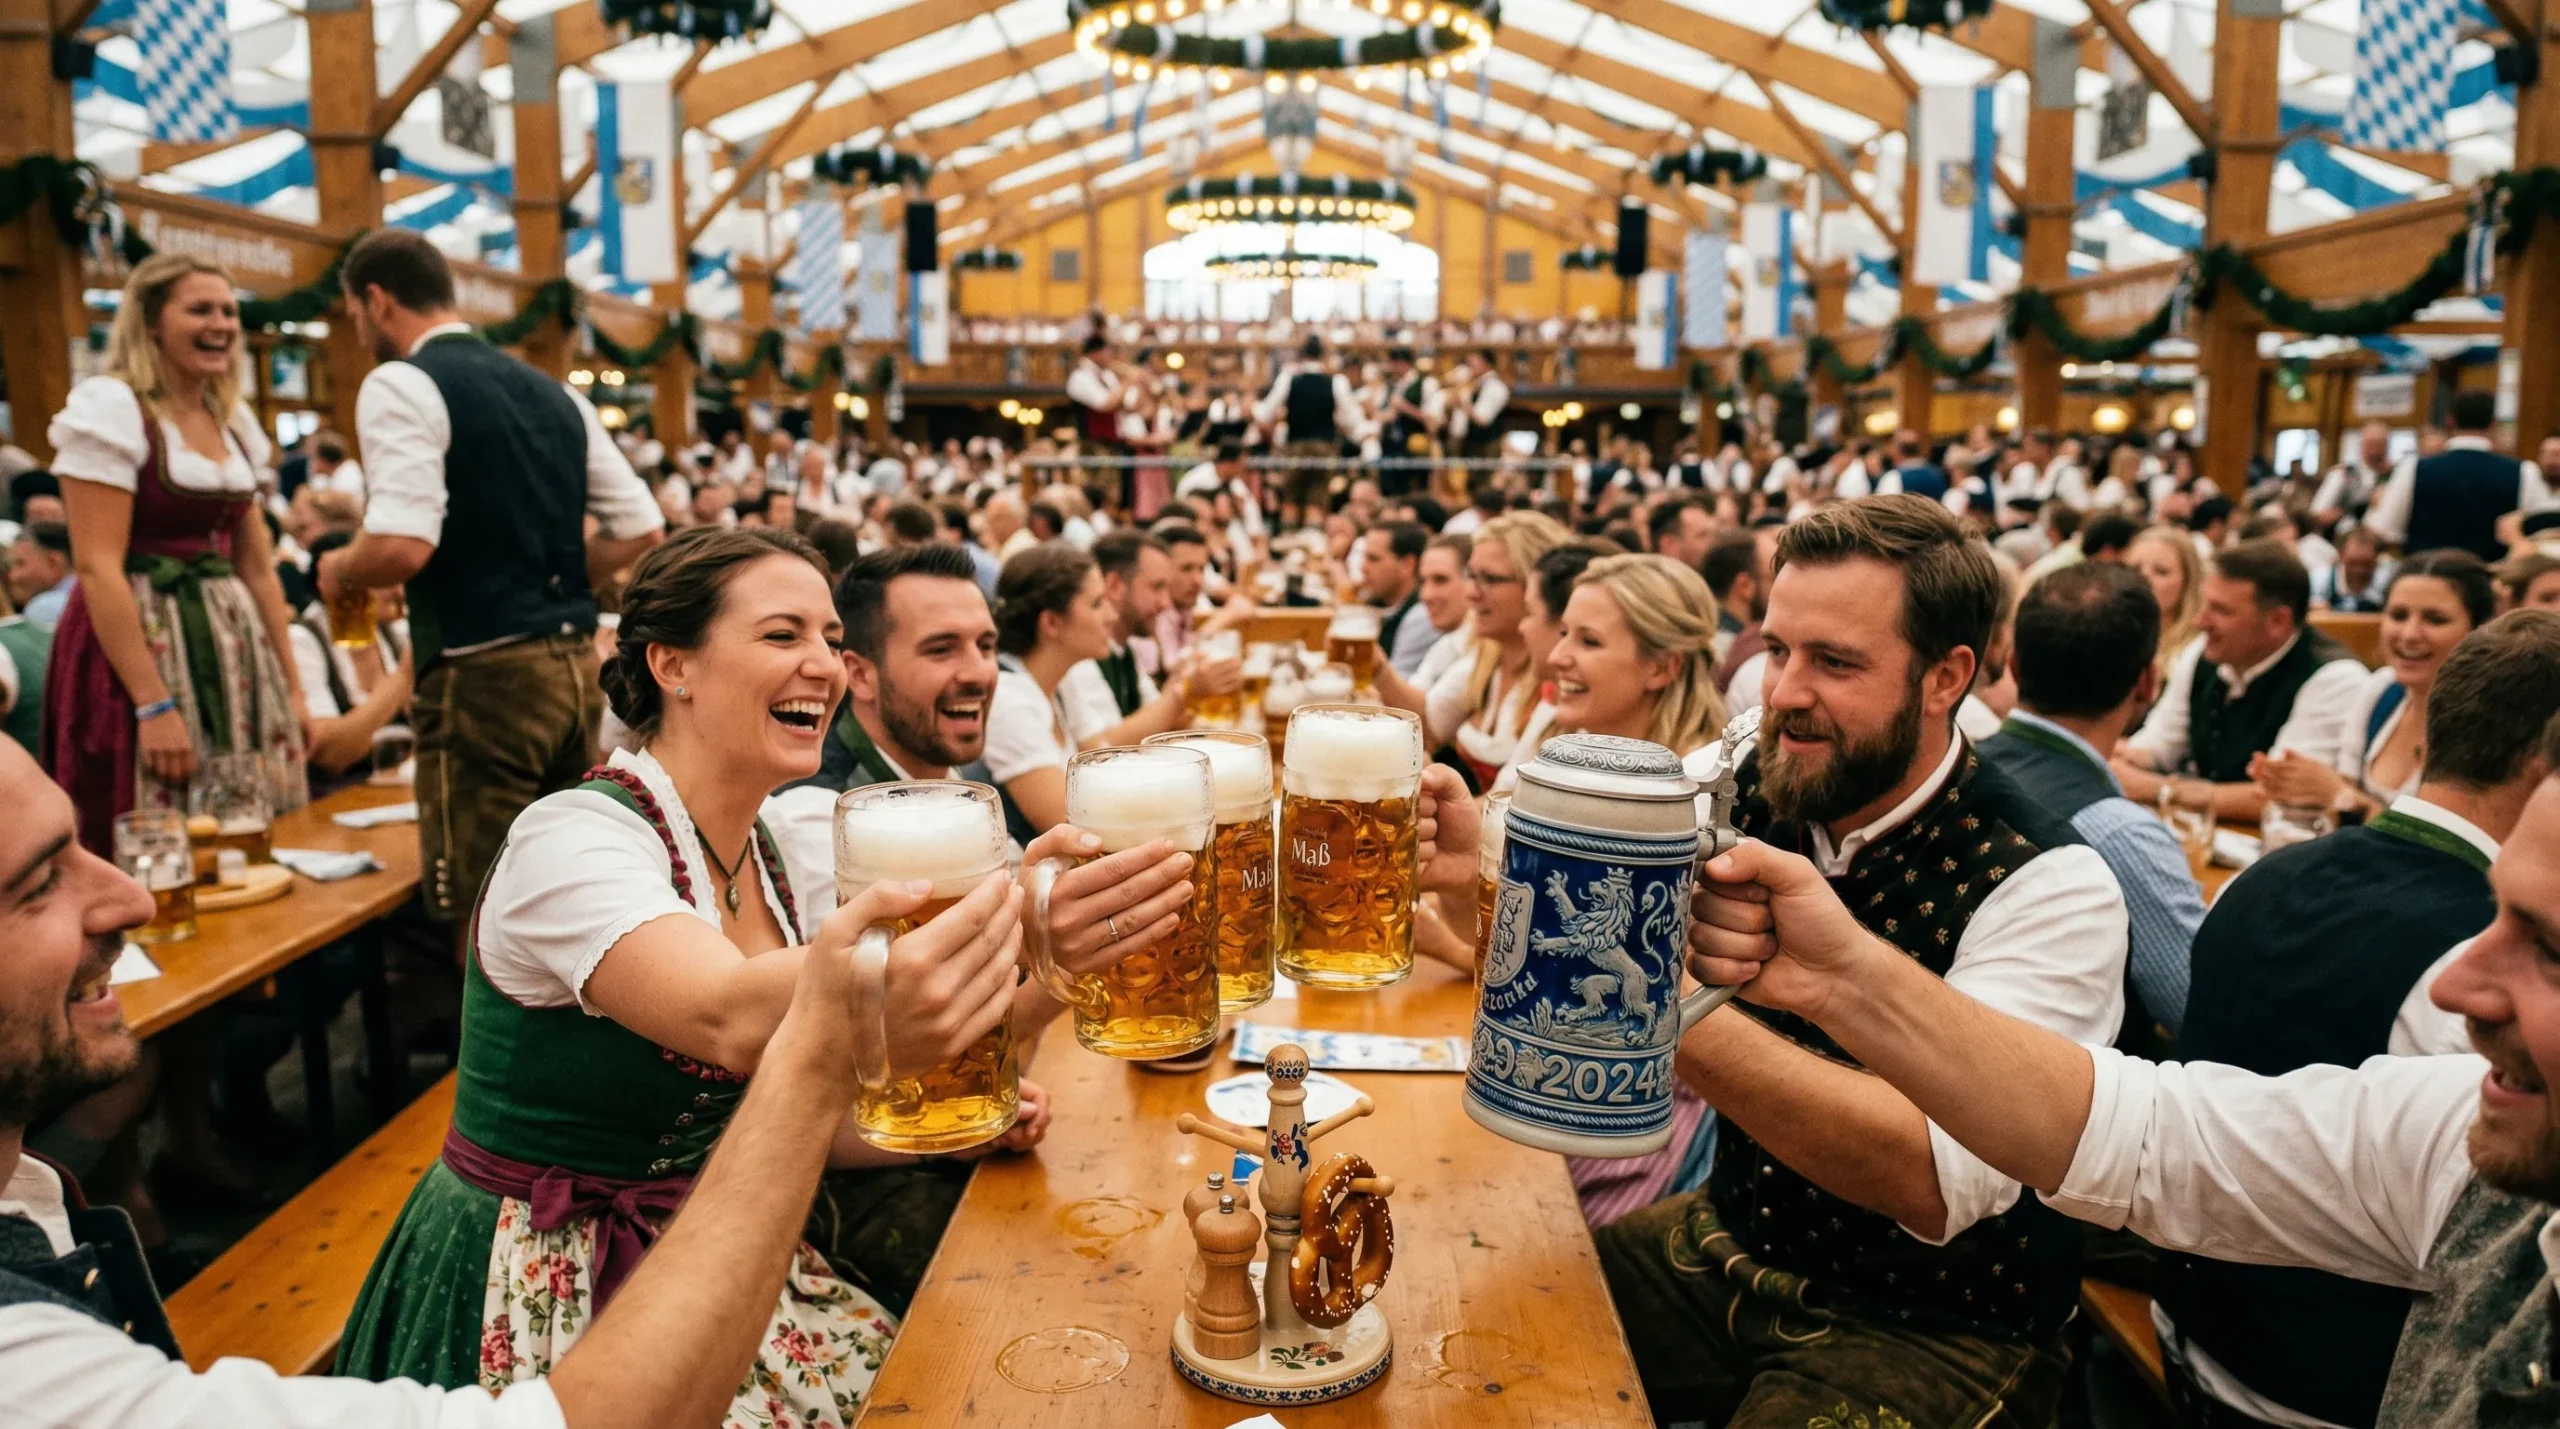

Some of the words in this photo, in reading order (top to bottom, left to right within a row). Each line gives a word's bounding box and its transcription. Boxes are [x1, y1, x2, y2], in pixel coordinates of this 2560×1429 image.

[1291, 837, 1331, 867] Maß
[1240, 859, 1273, 893] Maß
[1540, 1054, 1657, 1103] 2024
